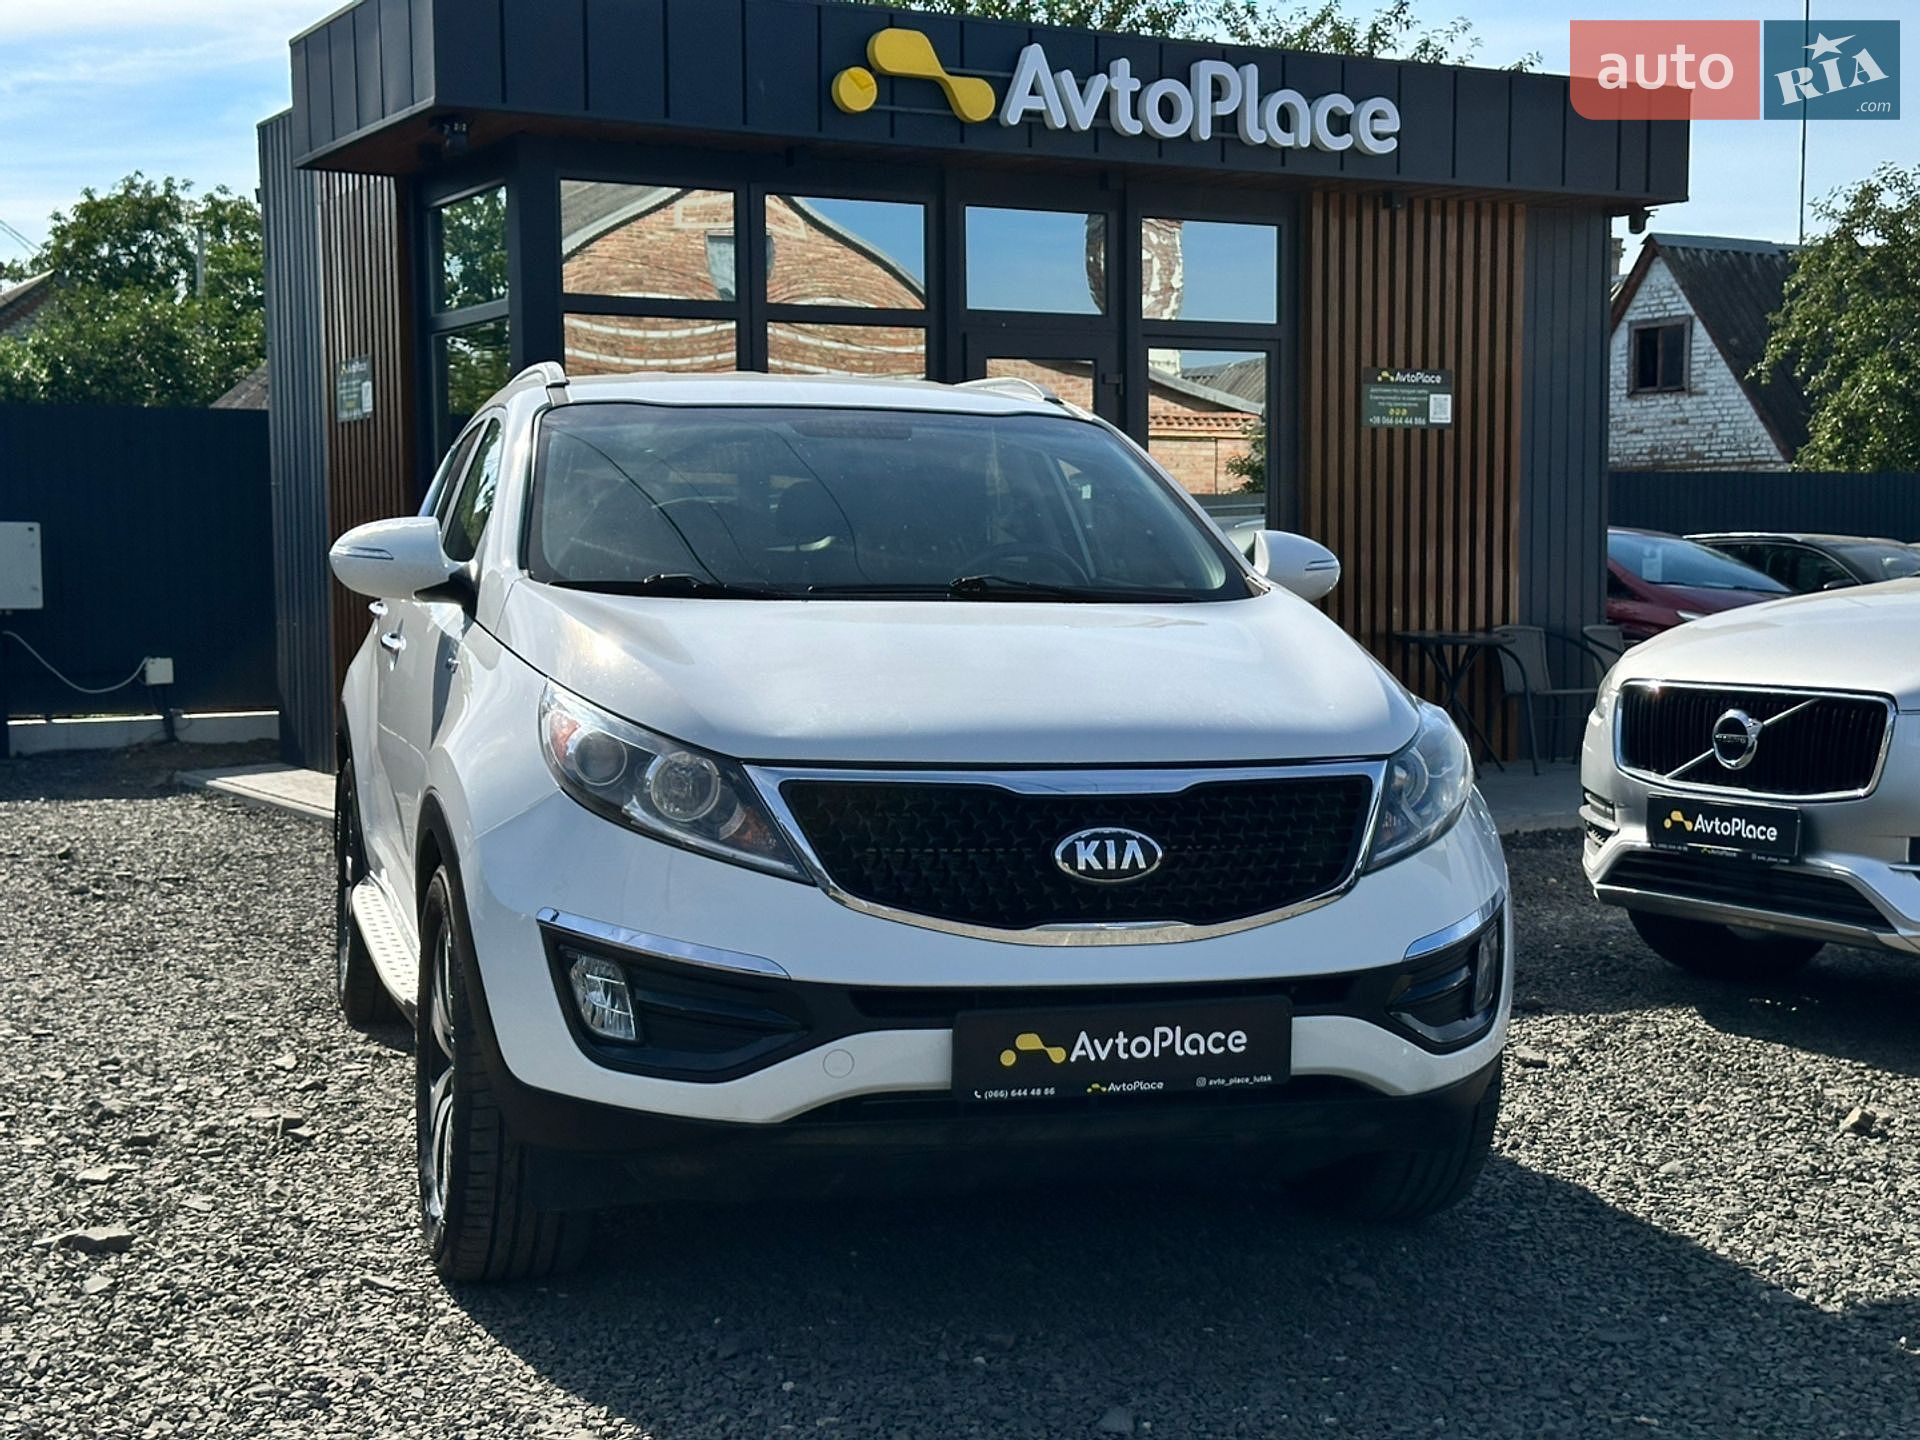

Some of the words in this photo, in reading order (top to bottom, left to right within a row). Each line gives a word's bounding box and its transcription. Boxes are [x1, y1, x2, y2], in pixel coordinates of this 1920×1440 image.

[999, 43, 1401, 156] AvtoPlace
[1394, 372, 1442, 384] AvtoPlace
[1693, 813, 1778, 842] AvtoPlace
[1074, 839, 1147, 871] KIA
[1069, 1025, 1248, 1063] AvtoPlace
[1107, 1080, 1164, 1093] AvtoPlace
